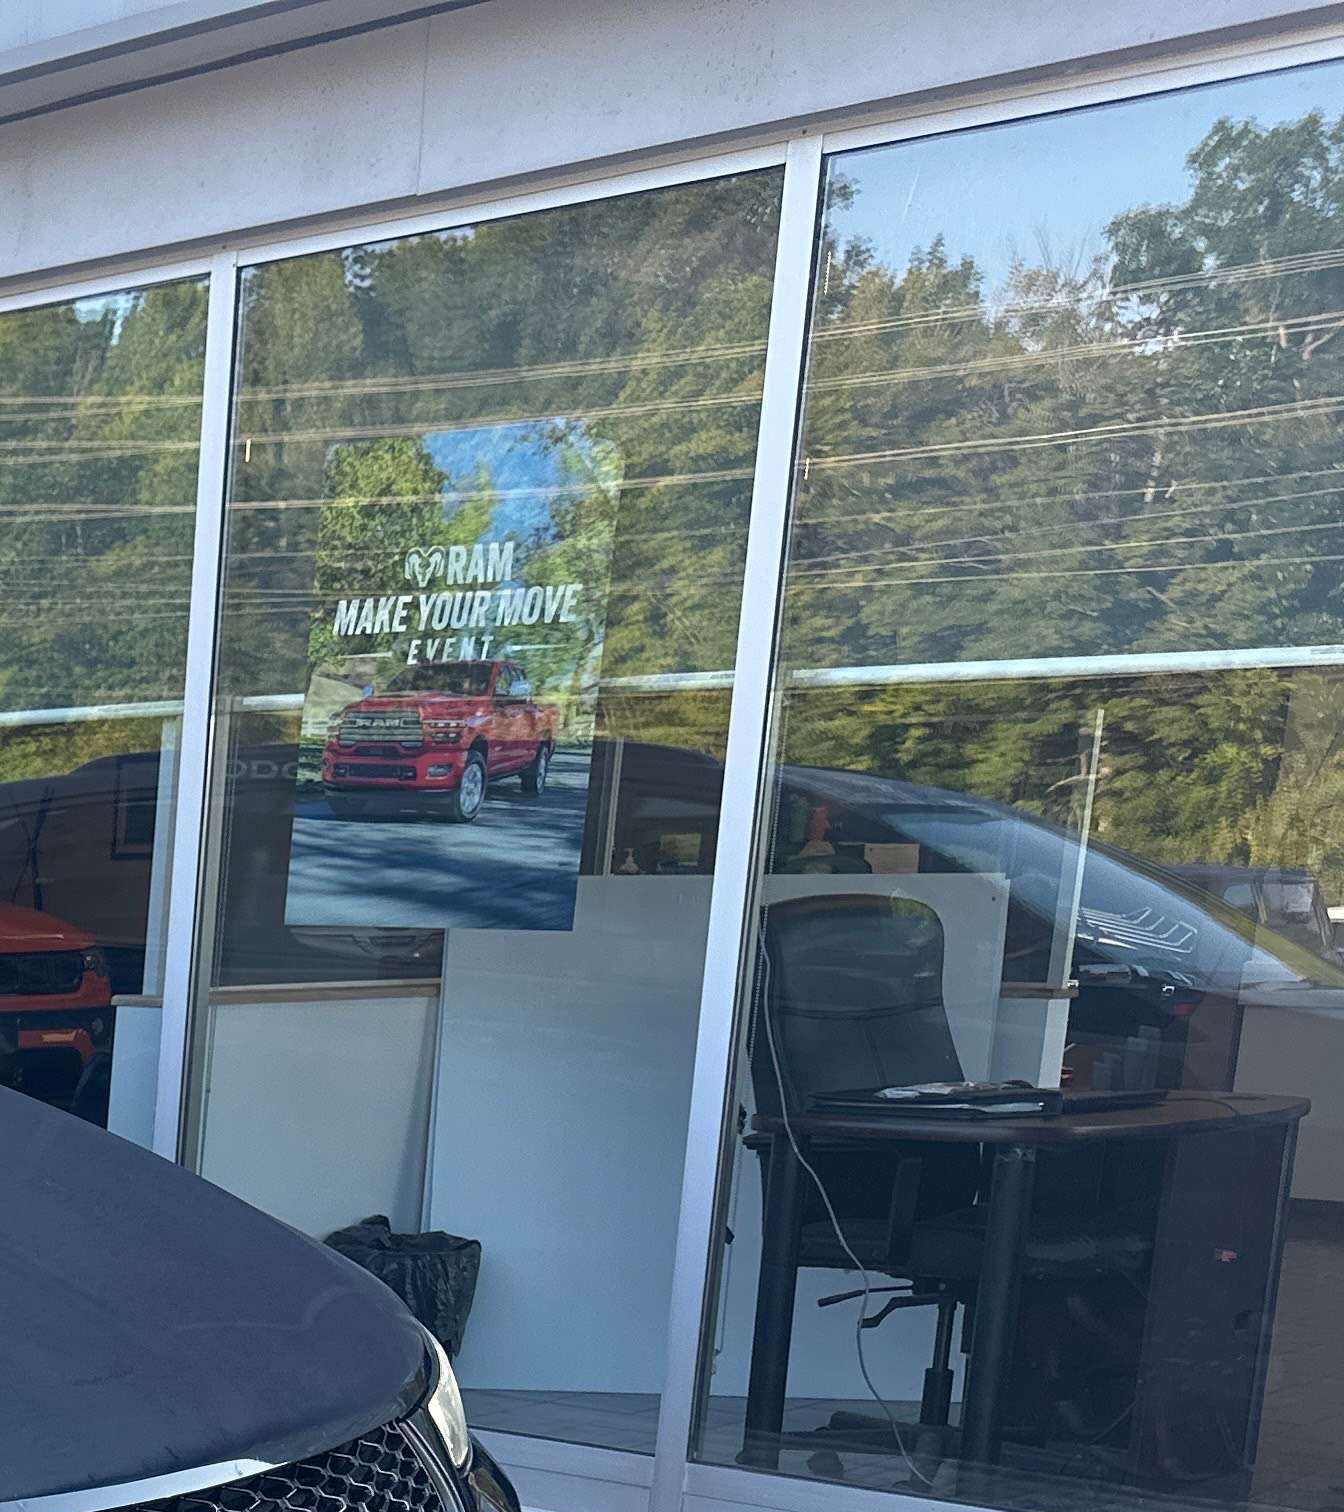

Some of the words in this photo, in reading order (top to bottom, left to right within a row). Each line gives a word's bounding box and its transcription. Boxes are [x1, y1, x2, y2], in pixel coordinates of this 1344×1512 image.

[447, 541, 515, 586] RAM
[332, 595, 413, 637] MAKE
[417, 590, 496, 632] YOUR
[494, 583, 584, 627] MOVE
[406, 635, 494, 666] EVENT
